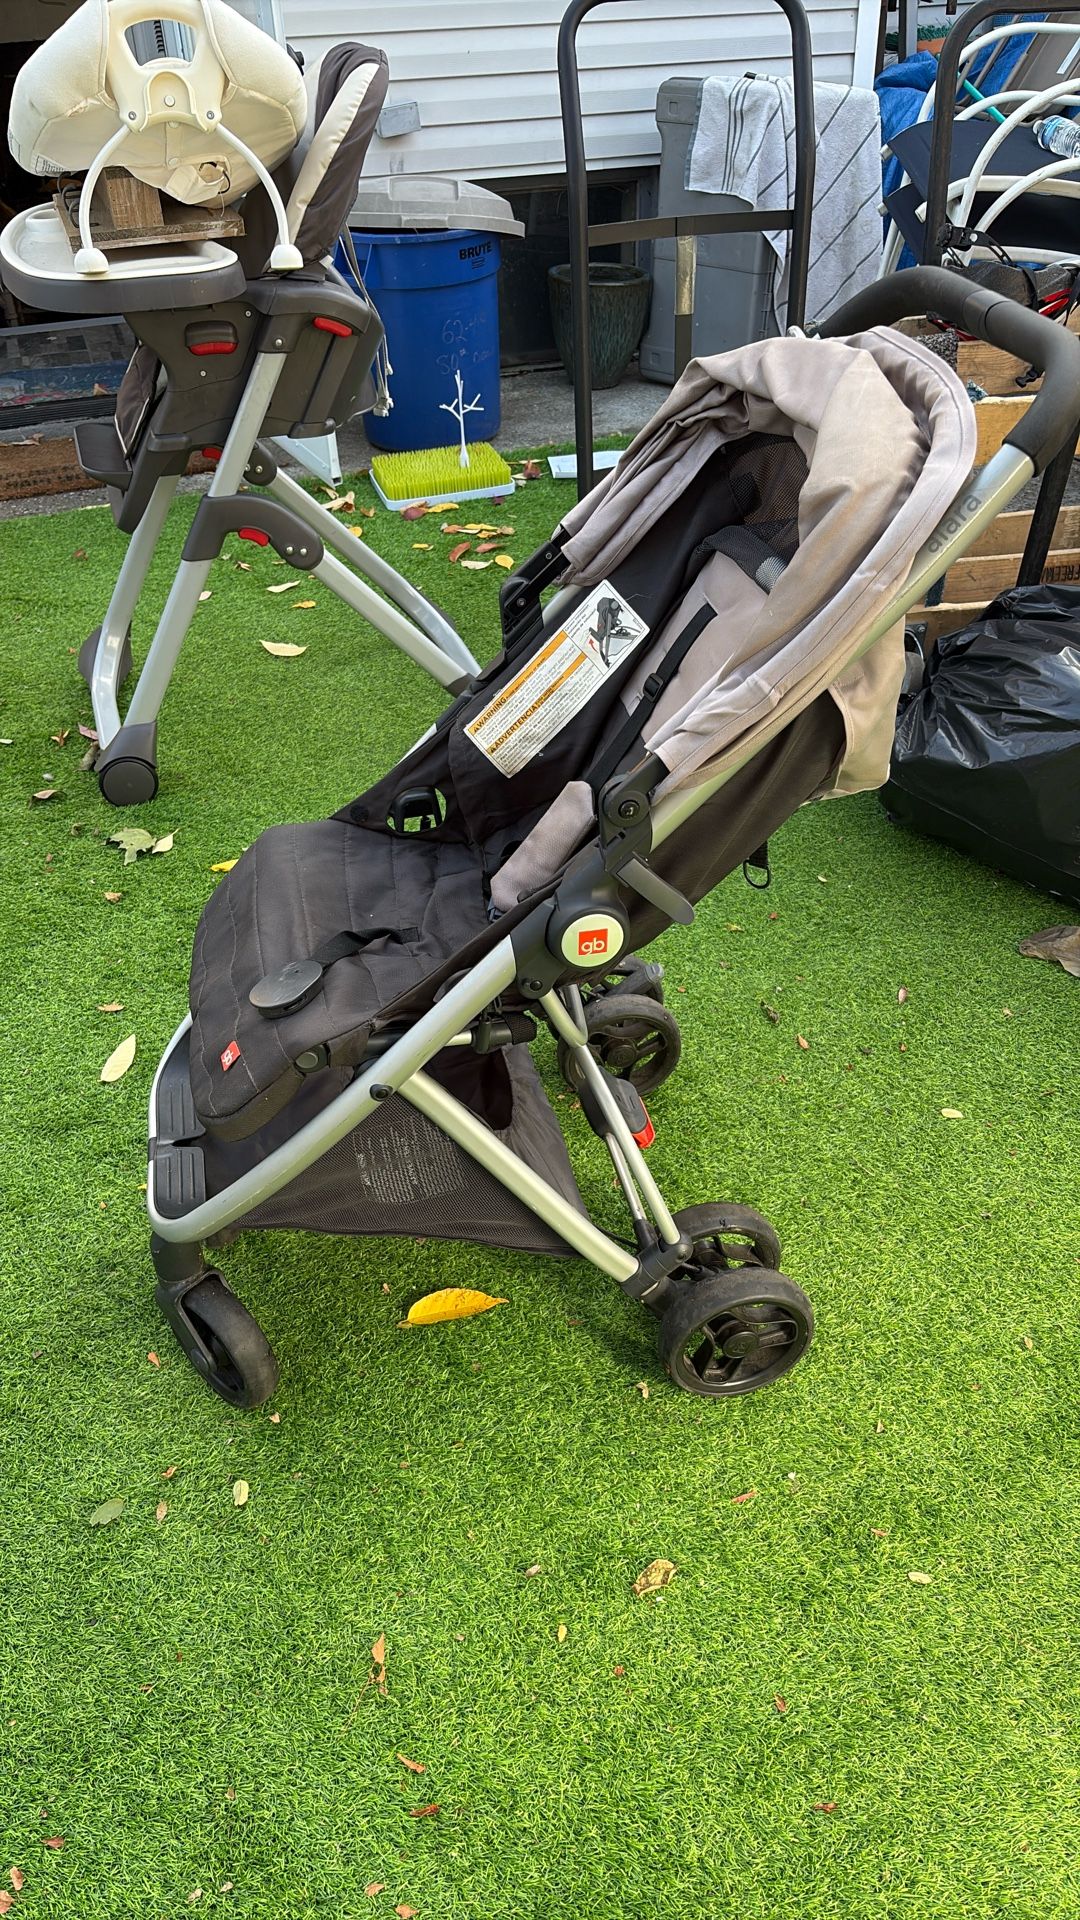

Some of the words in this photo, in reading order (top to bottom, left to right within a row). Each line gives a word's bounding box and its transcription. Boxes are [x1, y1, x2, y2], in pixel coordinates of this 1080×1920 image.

[459, 241, 491, 260] BRUTE
[475, 695, 507, 728] WARNING
[492, 702, 538, 749] ADVERTENCIA
[581, 937, 605, 956] gb
